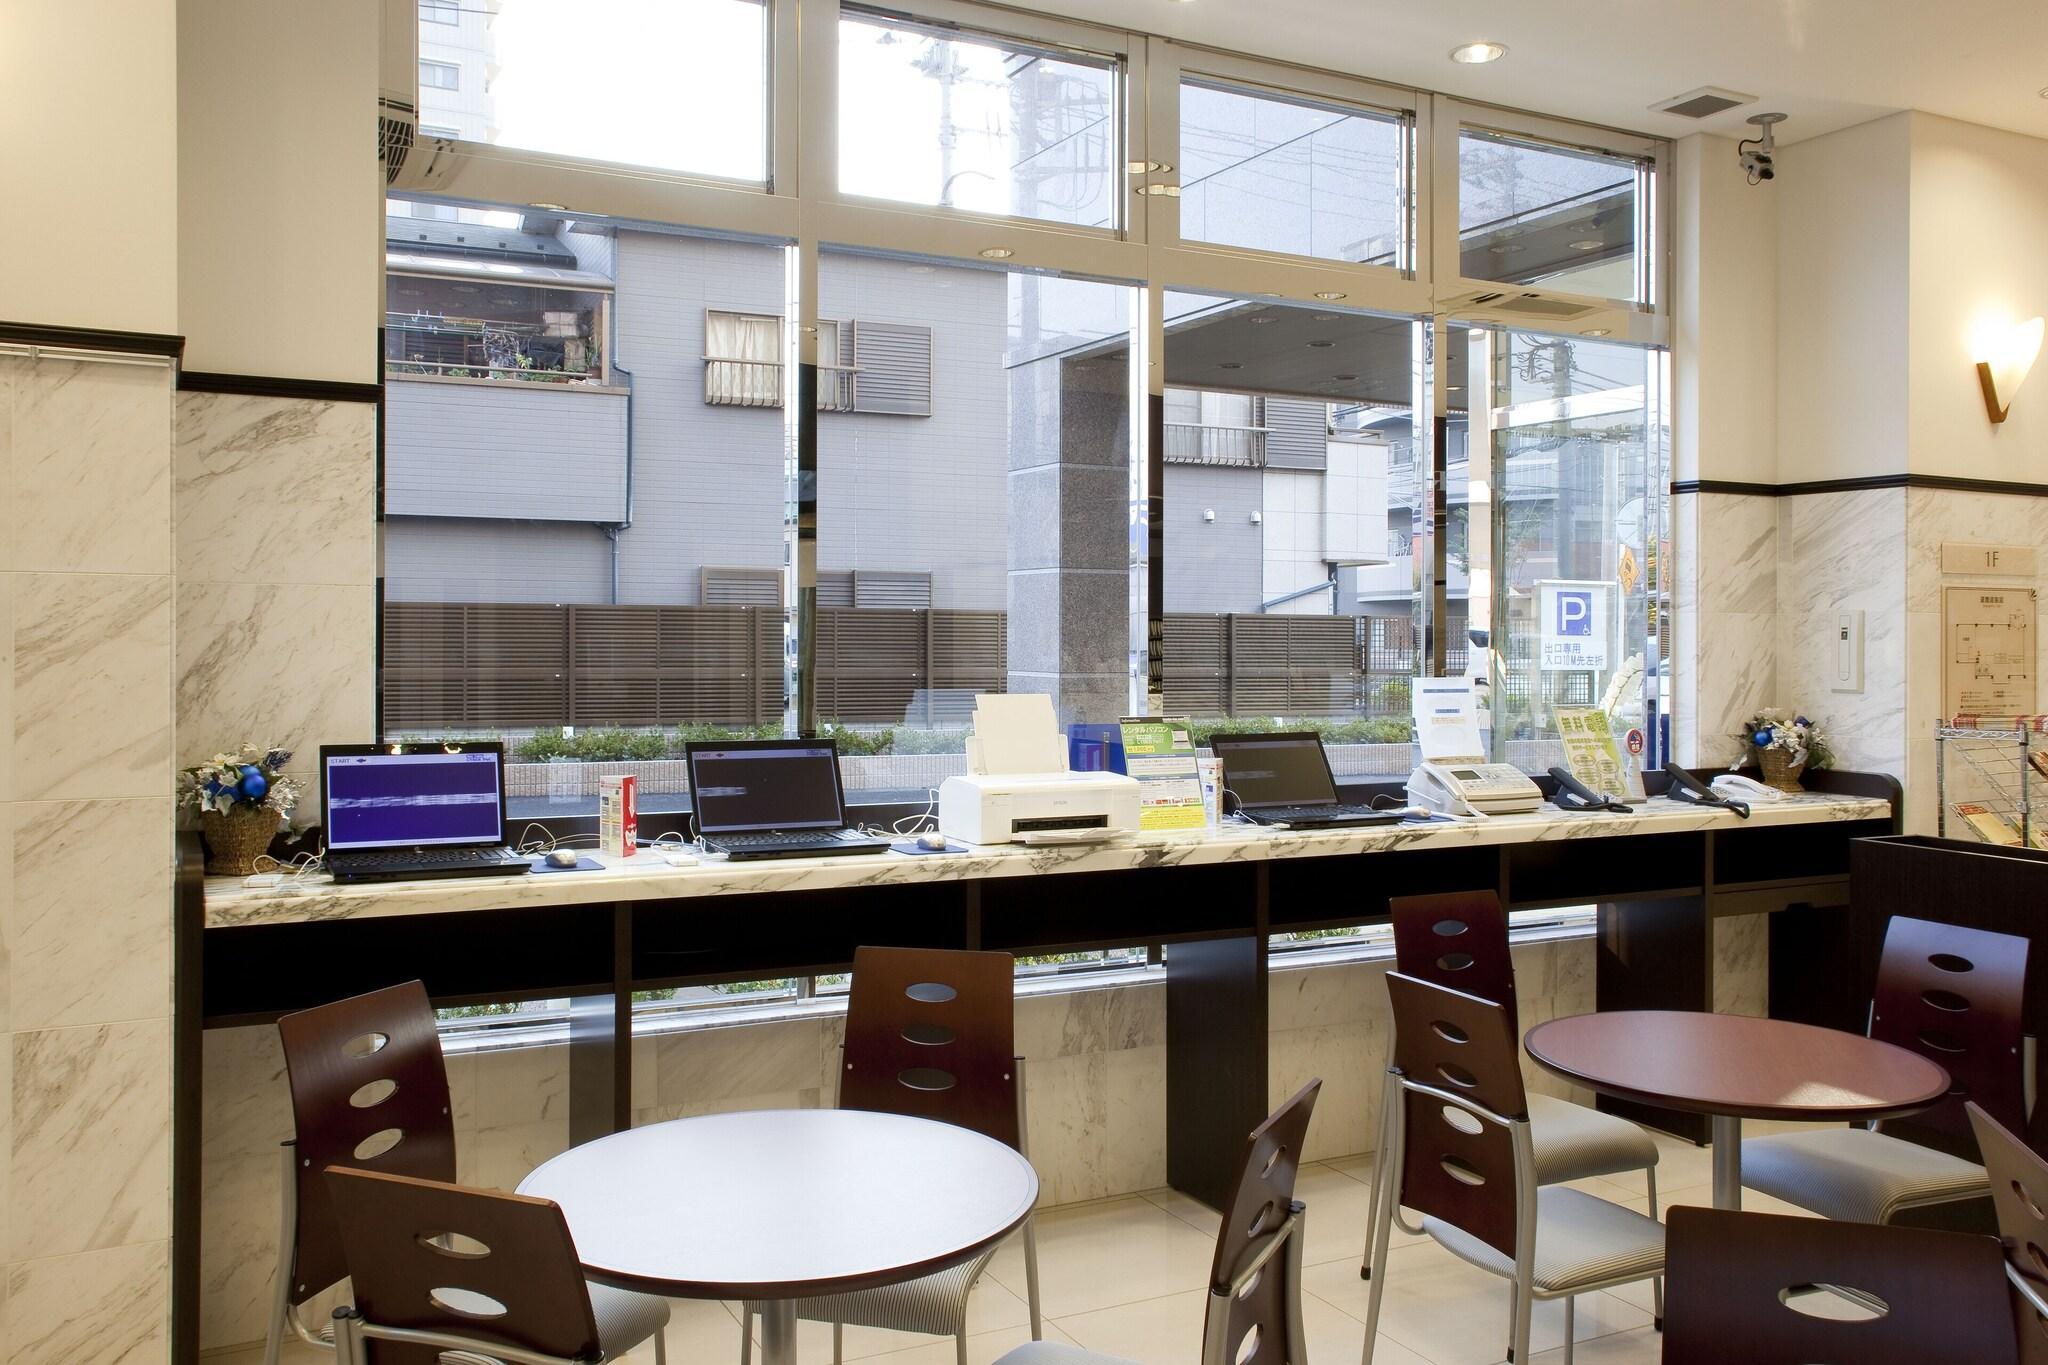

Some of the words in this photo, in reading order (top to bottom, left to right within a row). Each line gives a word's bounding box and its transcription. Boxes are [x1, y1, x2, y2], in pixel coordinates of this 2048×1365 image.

[1985, 551, 1999, 568] 1F
[1561, 596, 1587, 631] P
[1544, 642, 1581, 654] 出口専用
